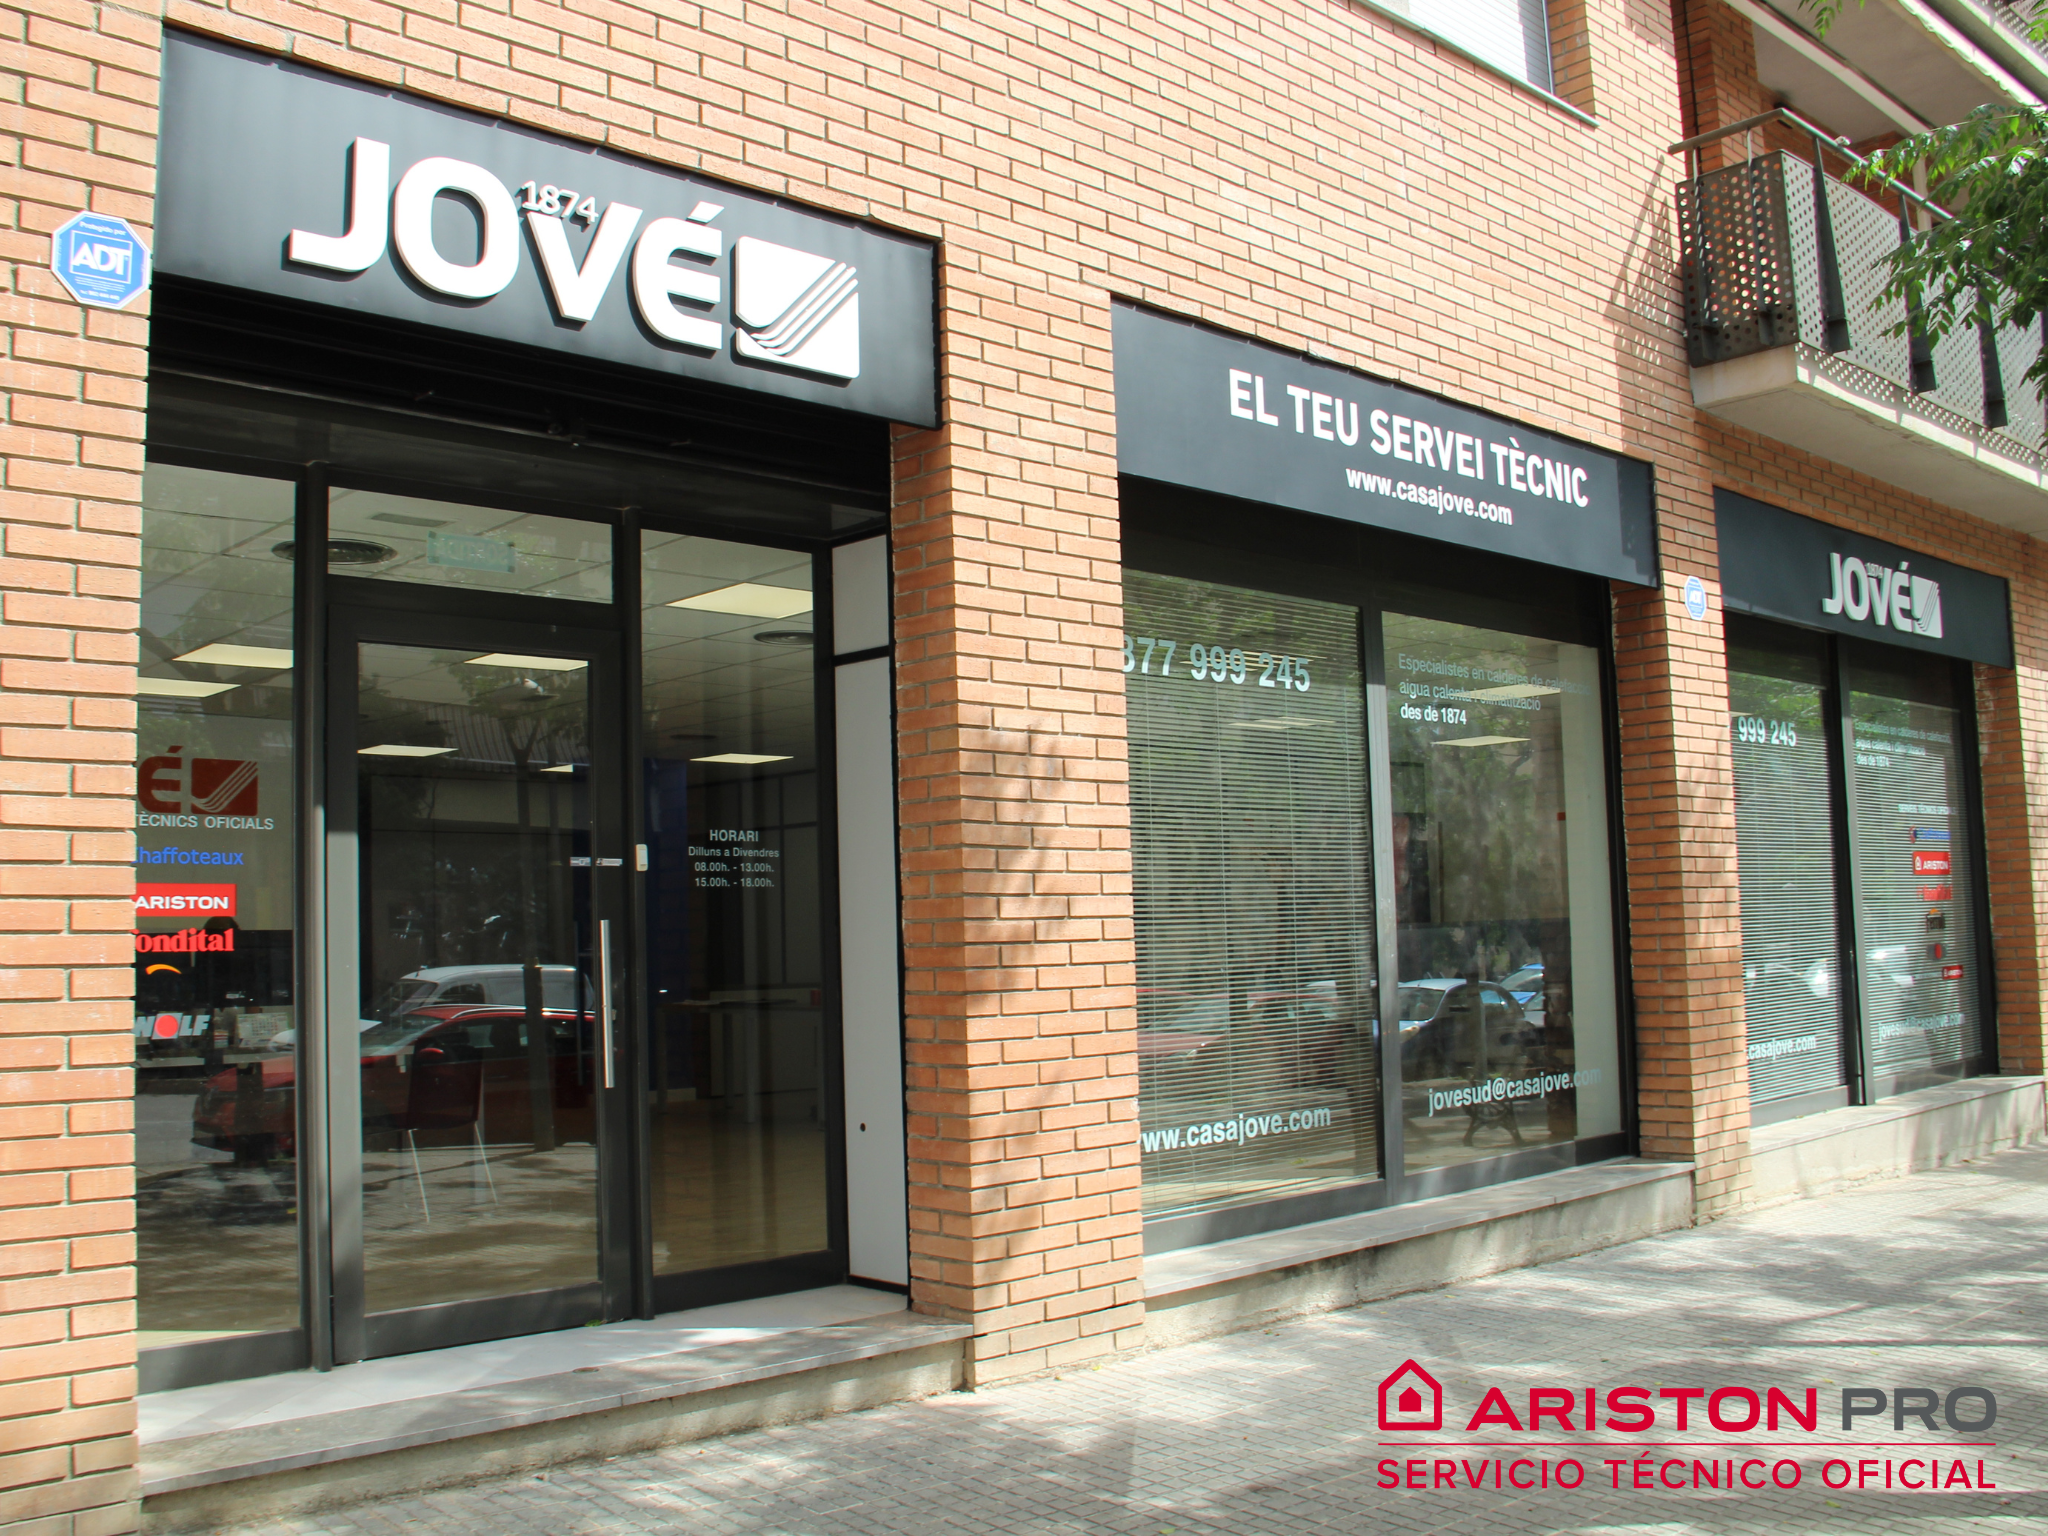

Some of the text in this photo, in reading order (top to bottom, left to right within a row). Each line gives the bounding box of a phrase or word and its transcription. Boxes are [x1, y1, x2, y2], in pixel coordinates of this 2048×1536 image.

[521, 180, 599, 224] 1874
[71, 242, 131, 275] ADT
[289, 137, 722, 350] JOVÉ
[1228, 368, 1589, 508] EL TEU SERVEI TÈCNIC
[1346, 469, 1513, 526] www.casajove.com
[1822, 552, 1912, 632] JOVÉ
[1190, 643, 1246, 685] 999
[1258, 652, 1310, 692] 245
[1398, 653, 1469, 678] Especialistes
[1472, 668, 1485, 681] en
[1487, 669, 1528, 685] calderes
[1530, 674, 1543, 688] de
[1400, 679, 1430, 699] aigua
[1433, 684, 1472, 703] calenta
[1480, 692, 1541, 711] climatització
[1400, 703, 1467, 725] des de 1874
[1738, 716, 1796, 747] 999 245
[204, 816, 275, 830] OFICIALS
[709, 829, 759, 842] HORARI
[688, 846, 721, 856] Dilluns
[732, 847, 780, 857] Divendres
[694, 862, 730, 872] 08.00h.
[740, 863, 774, 872] 13.00h.
[695, 877, 730, 887] 15.00h.
[740, 877, 774, 887] 18.00h.
[135, 896, 229, 909] ARISTON
[1428, 1068, 1602, 1118] jovesud@casajove.com
[1138, 1107, 1331, 1153] ww.casajove.com
